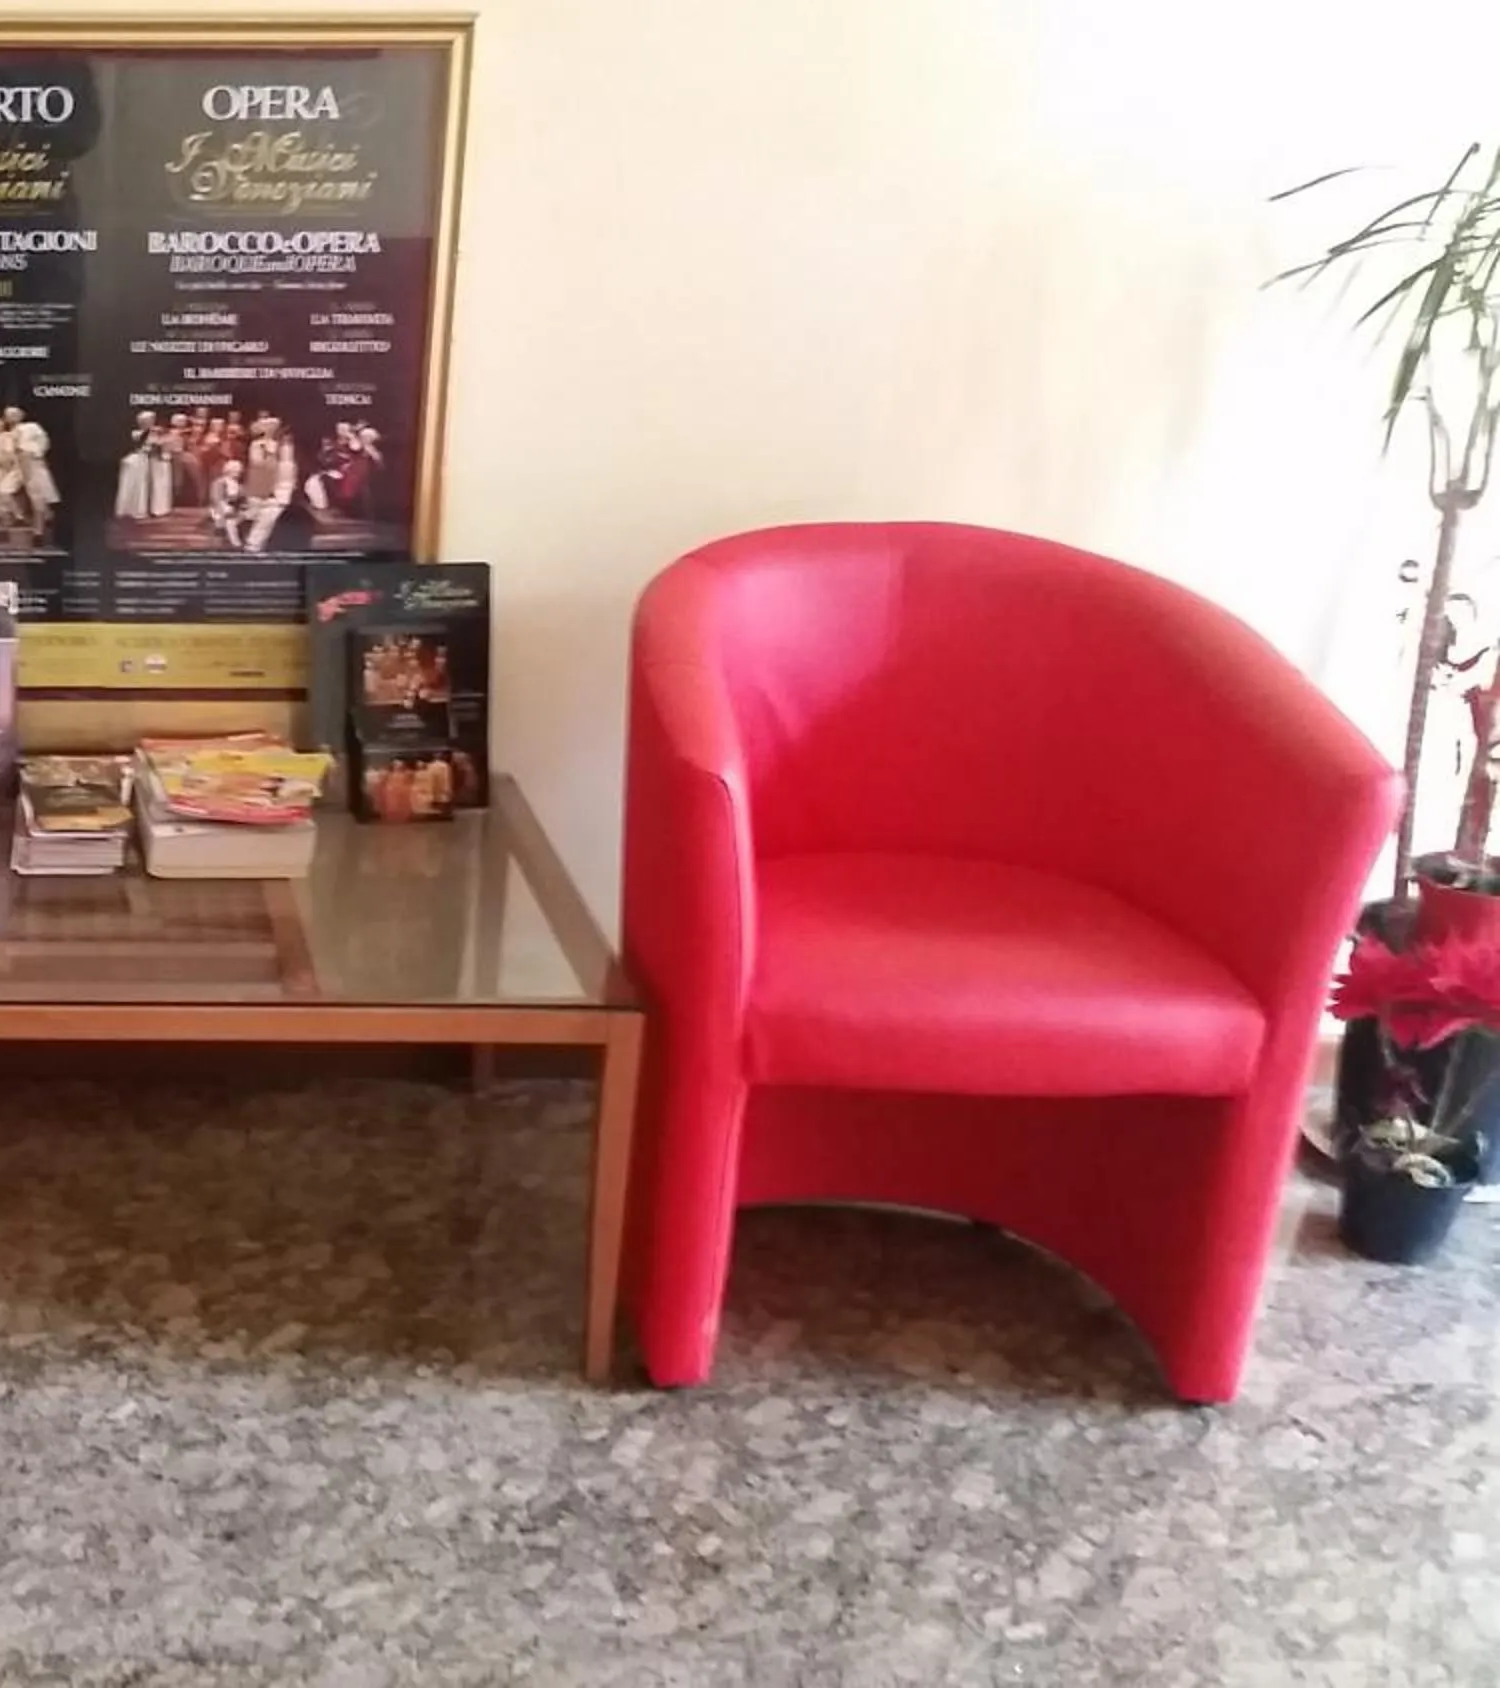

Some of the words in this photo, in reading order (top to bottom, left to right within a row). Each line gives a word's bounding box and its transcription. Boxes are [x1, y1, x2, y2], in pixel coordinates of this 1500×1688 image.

[202, 85, 340, 120] OPERA
[228, 131, 361, 173] Musici
[190, 161, 378, 216] Veneziani
